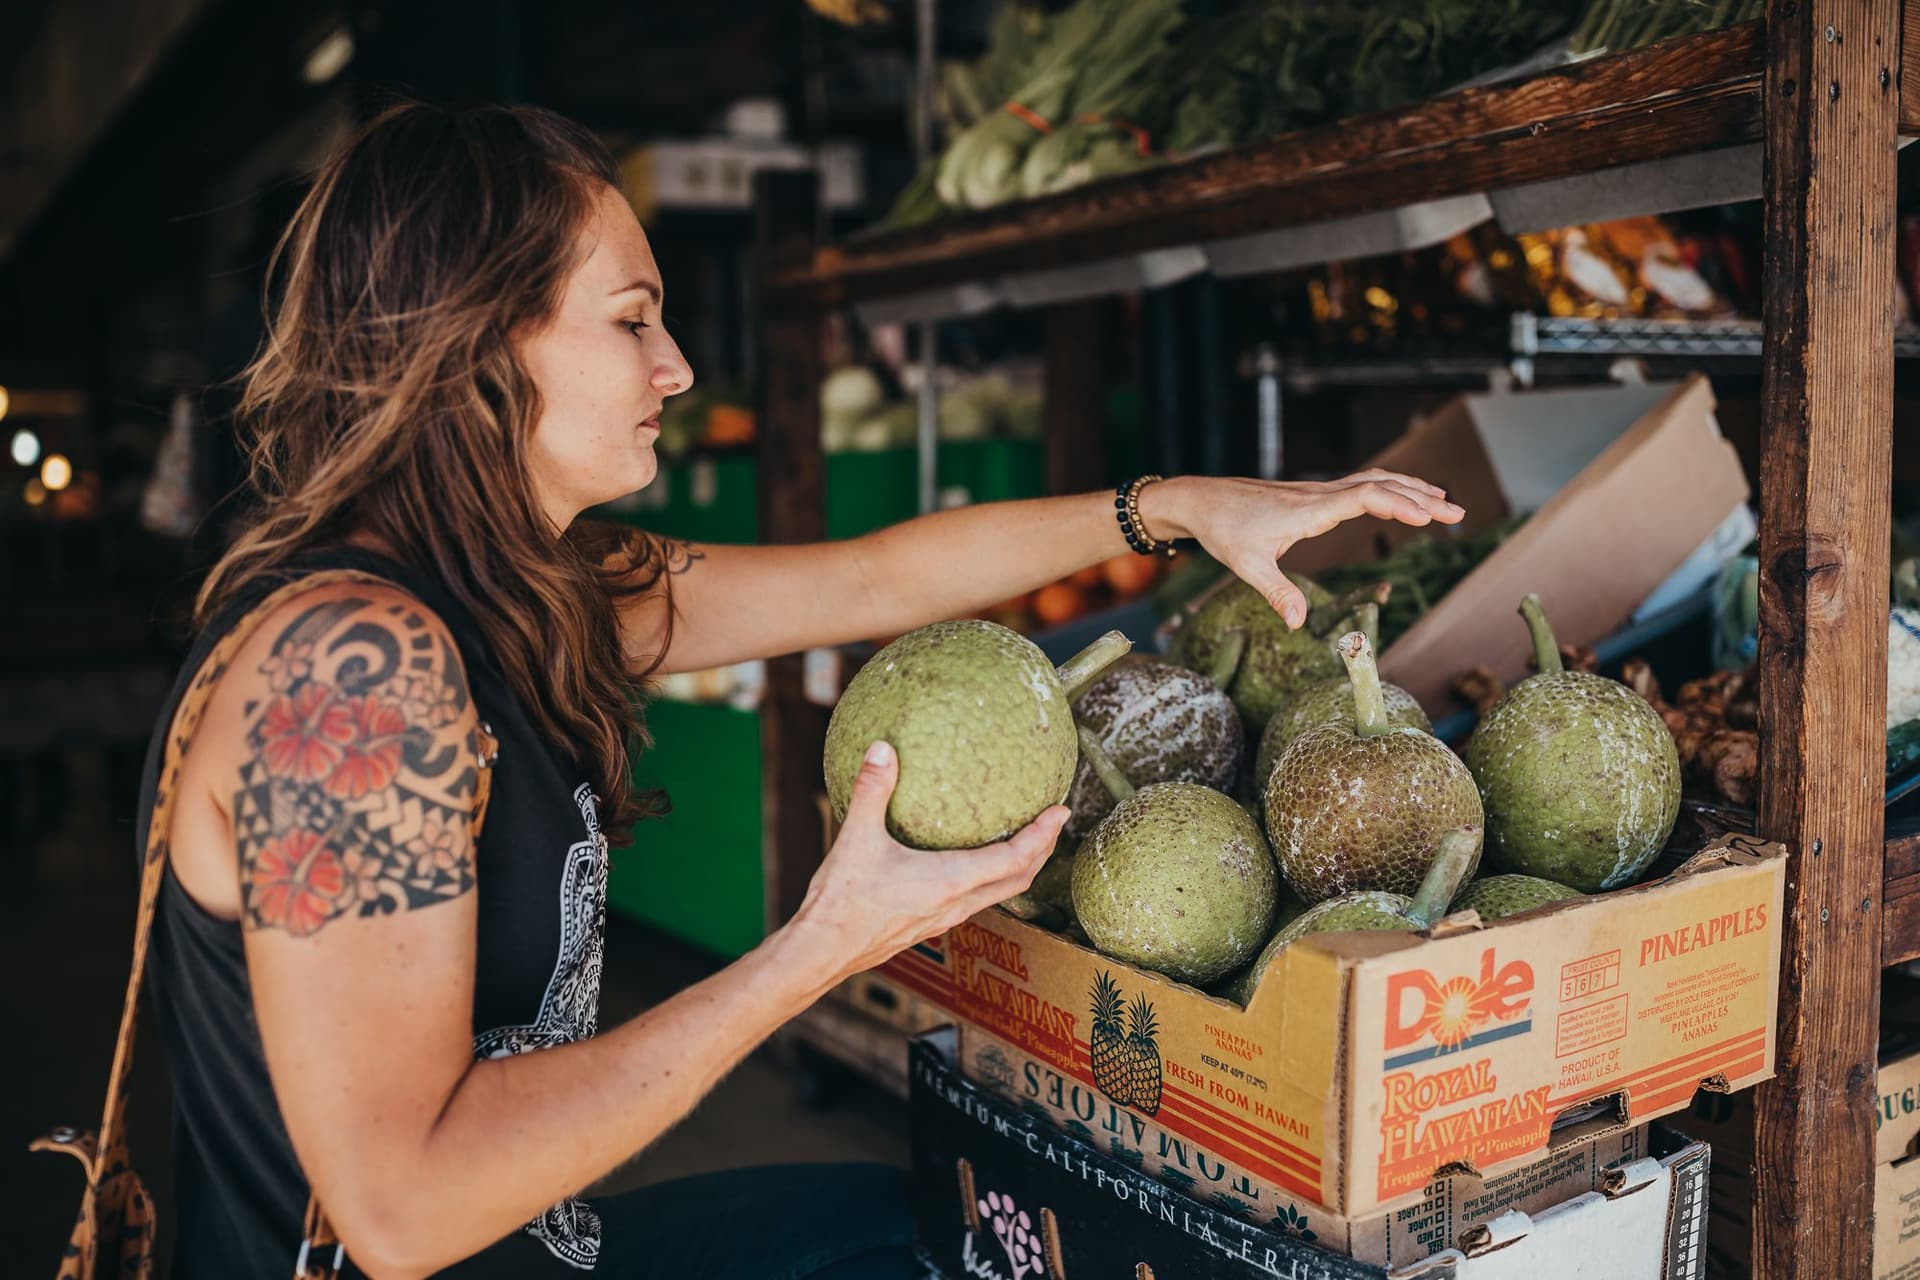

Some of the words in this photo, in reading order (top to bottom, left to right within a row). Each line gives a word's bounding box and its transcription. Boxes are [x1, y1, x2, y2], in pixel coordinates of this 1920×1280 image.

[1639, 903, 1767, 967] PINEAPPLES
[1567, 964, 1588, 976] FRUIT
[1589, 954, 1614, 969] COUNT
[1565, 982, 1572, 996] 5
[1580, 978, 1587, 992] 6
[1594, 974, 1601, 988] 7
[952, 949, 1075, 1045] HAWAIIAN
[1384, 947, 1535, 1050] Dole
[1672, 1005, 1729, 1033] PINEAPPLES
[1204, 1023, 1264, 1057] PINEAPPLES
[1682, 1021, 1719, 1043] ANANAS
[1215, 1039, 1253, 1062] ANANAS
[1201, 1053, 1220, 1068] KEEP
[1220, 1062, 1229, 1073] AT
[1561, 1051, 1607, 1076] PRODUCT
[1608, 1047, 1621, 1061] OF
[1596, 1062, 1622, 1079] U.S.A.
[1383, 1058, 1497, 1119] ROYAL
[1166, 1060, 1205, 1090] FRESH
[1209, 1080, 1249, 1111] FROM
[1255, 1101, 1310, 1140] HAWAII
[1022, 1060, 1260, 1200] TOMATOES
[1380, 1085, 1550, 1166] HAWAIIAN
[1689, 1161, 1704, 1176] SIZE
[1026, 1132, 1219, 1246] CALIFORNIA
[1532, 1182, 1545, 1194] with
[1685, 1179, 1693, 1190] 16
[1463, 1199, 1479, 1212] food
[1480, 1192, 1494, 1204] with
[1397, 1206, 1420, 1222] LARGE
[1462, 1213, 1469, 1221] to
[1681, 1209, 1691, 1220] 20
[1408, 1215, 1433, 1234] LARGE
[1679, 1223, 1689, 1234] 22
[1417, 1229, 1433, 1245] MED
[1678, 1238, 1688, 1249] 32
[1677, 1252, 1686, 1263] 36
[1676, 1266, 1685, 1277] 40
